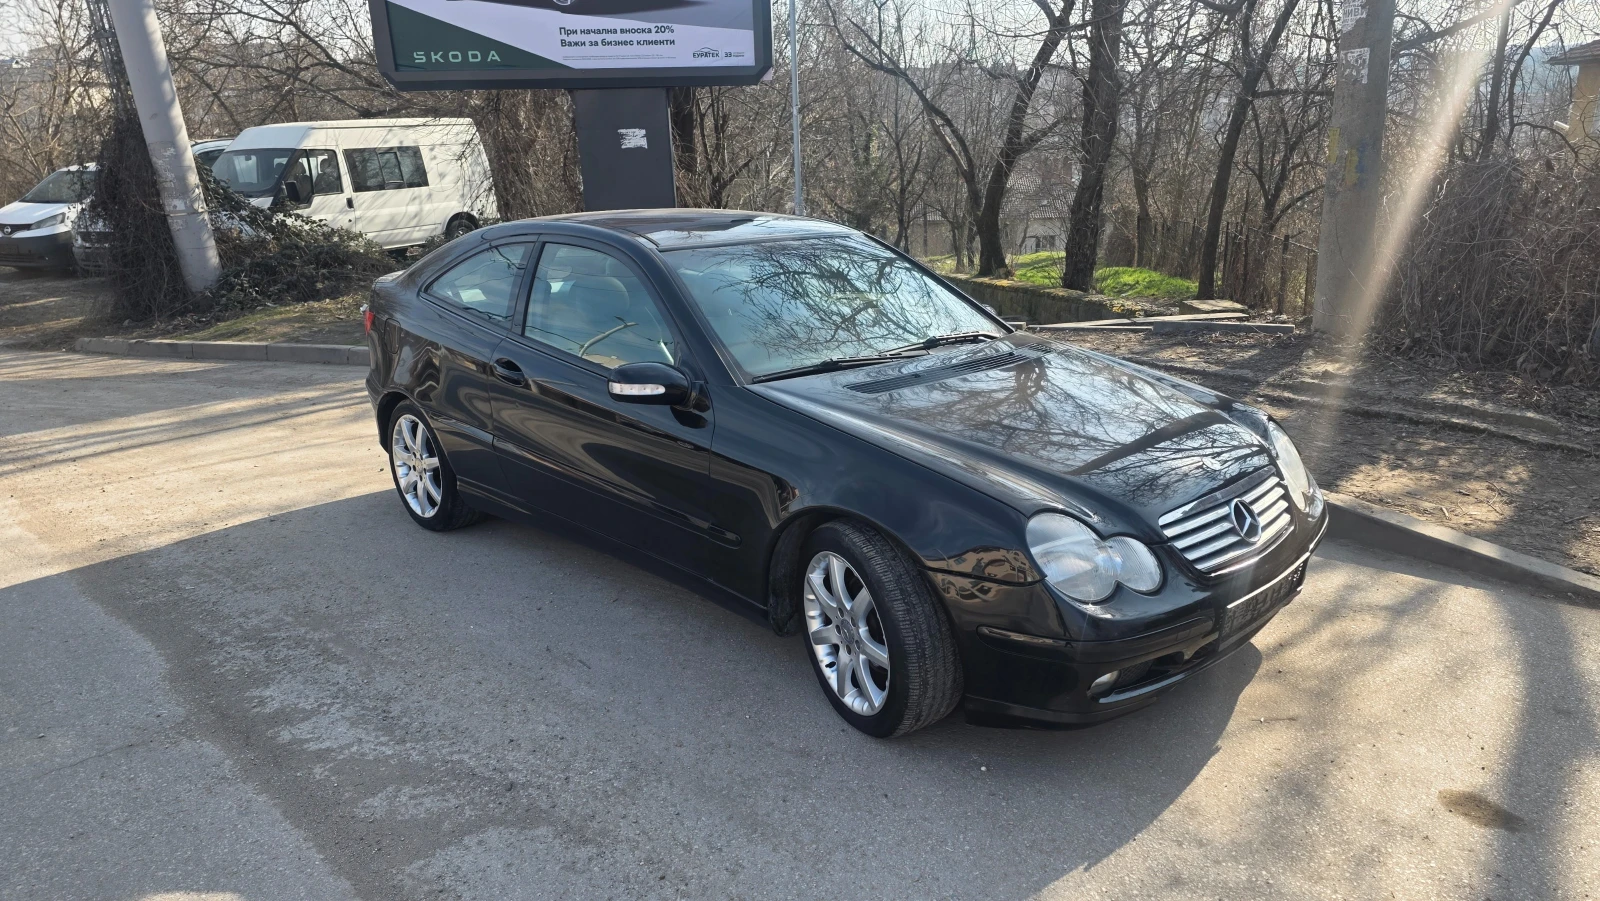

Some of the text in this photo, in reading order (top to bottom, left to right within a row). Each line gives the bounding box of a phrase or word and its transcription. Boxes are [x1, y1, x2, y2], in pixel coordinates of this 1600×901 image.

[559, 27, 578, 37] При
[654, 25, 675, 34] 20%
[560, 39, 586, 47] Важи
[600, 38, 635, 47] бизнес
[636, 38, 676, 46] клиенти
[413, 50, 501, 63] SKODA
